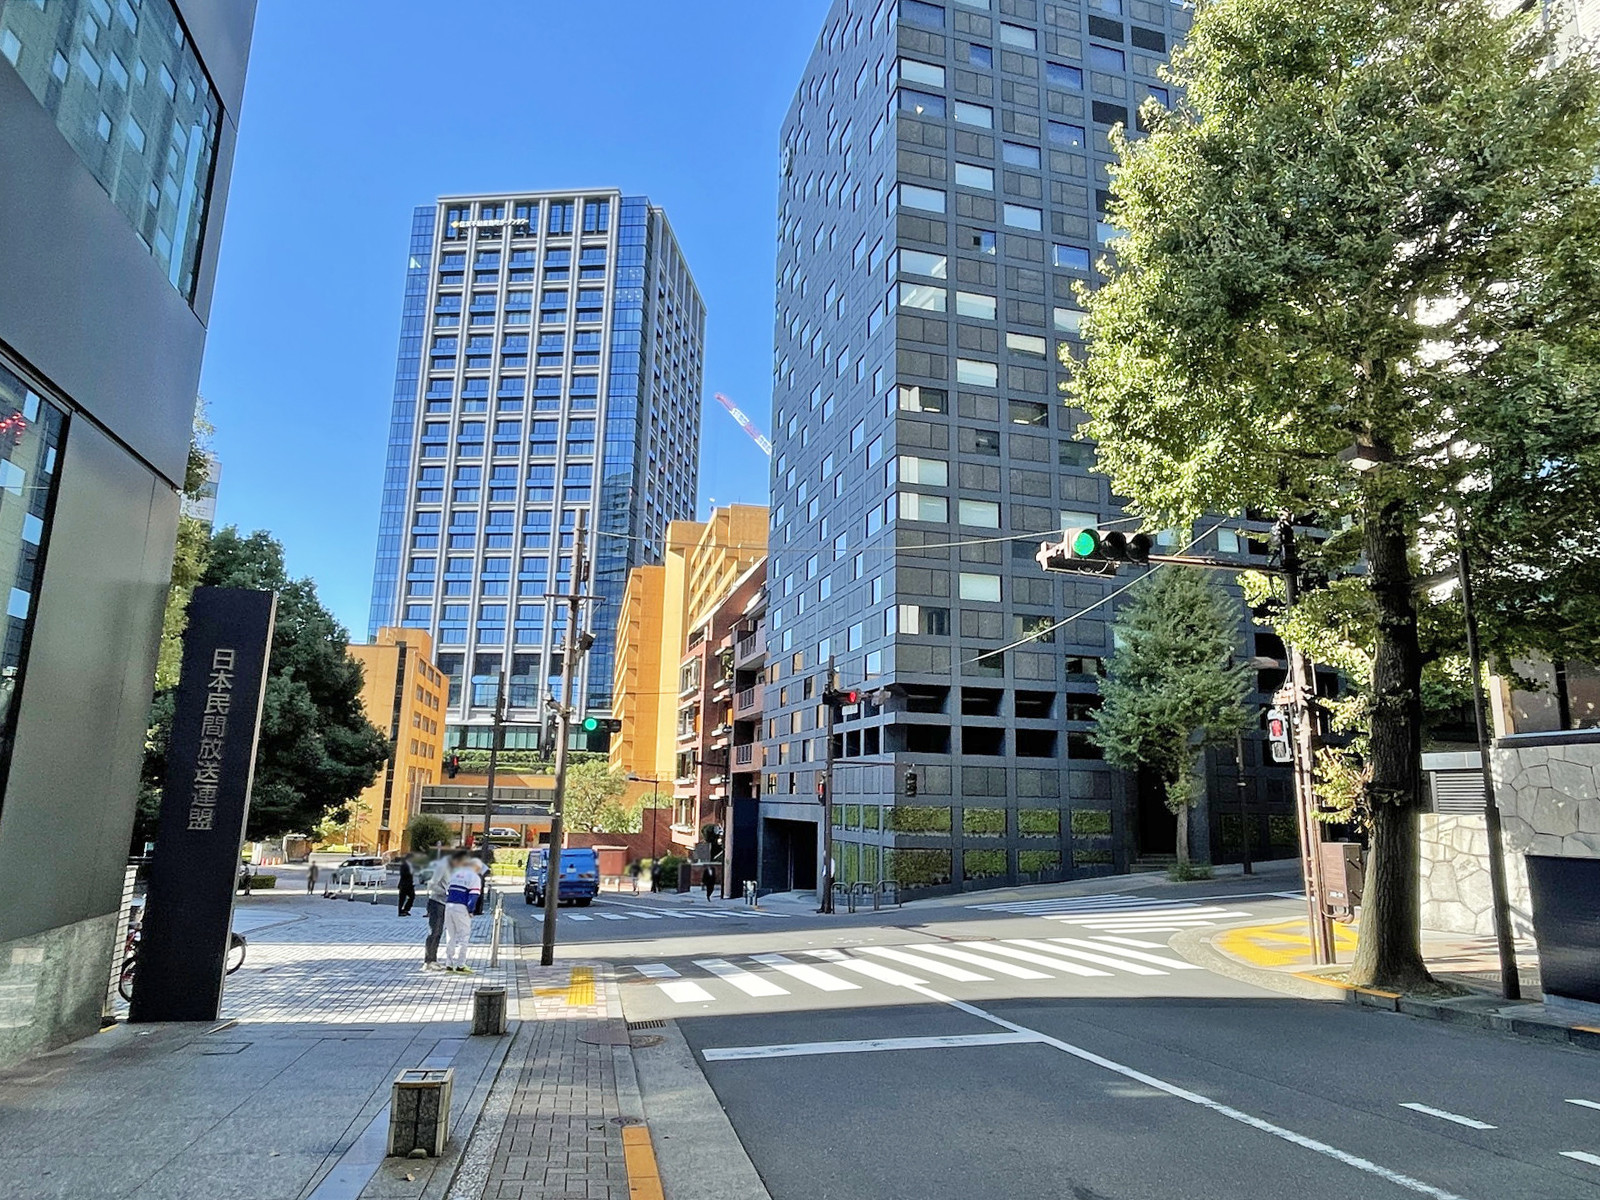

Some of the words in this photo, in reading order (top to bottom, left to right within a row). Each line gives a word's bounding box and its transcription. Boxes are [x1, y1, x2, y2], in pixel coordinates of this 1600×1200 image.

[187, 648, 235, 830] 日本民間放送連盟
